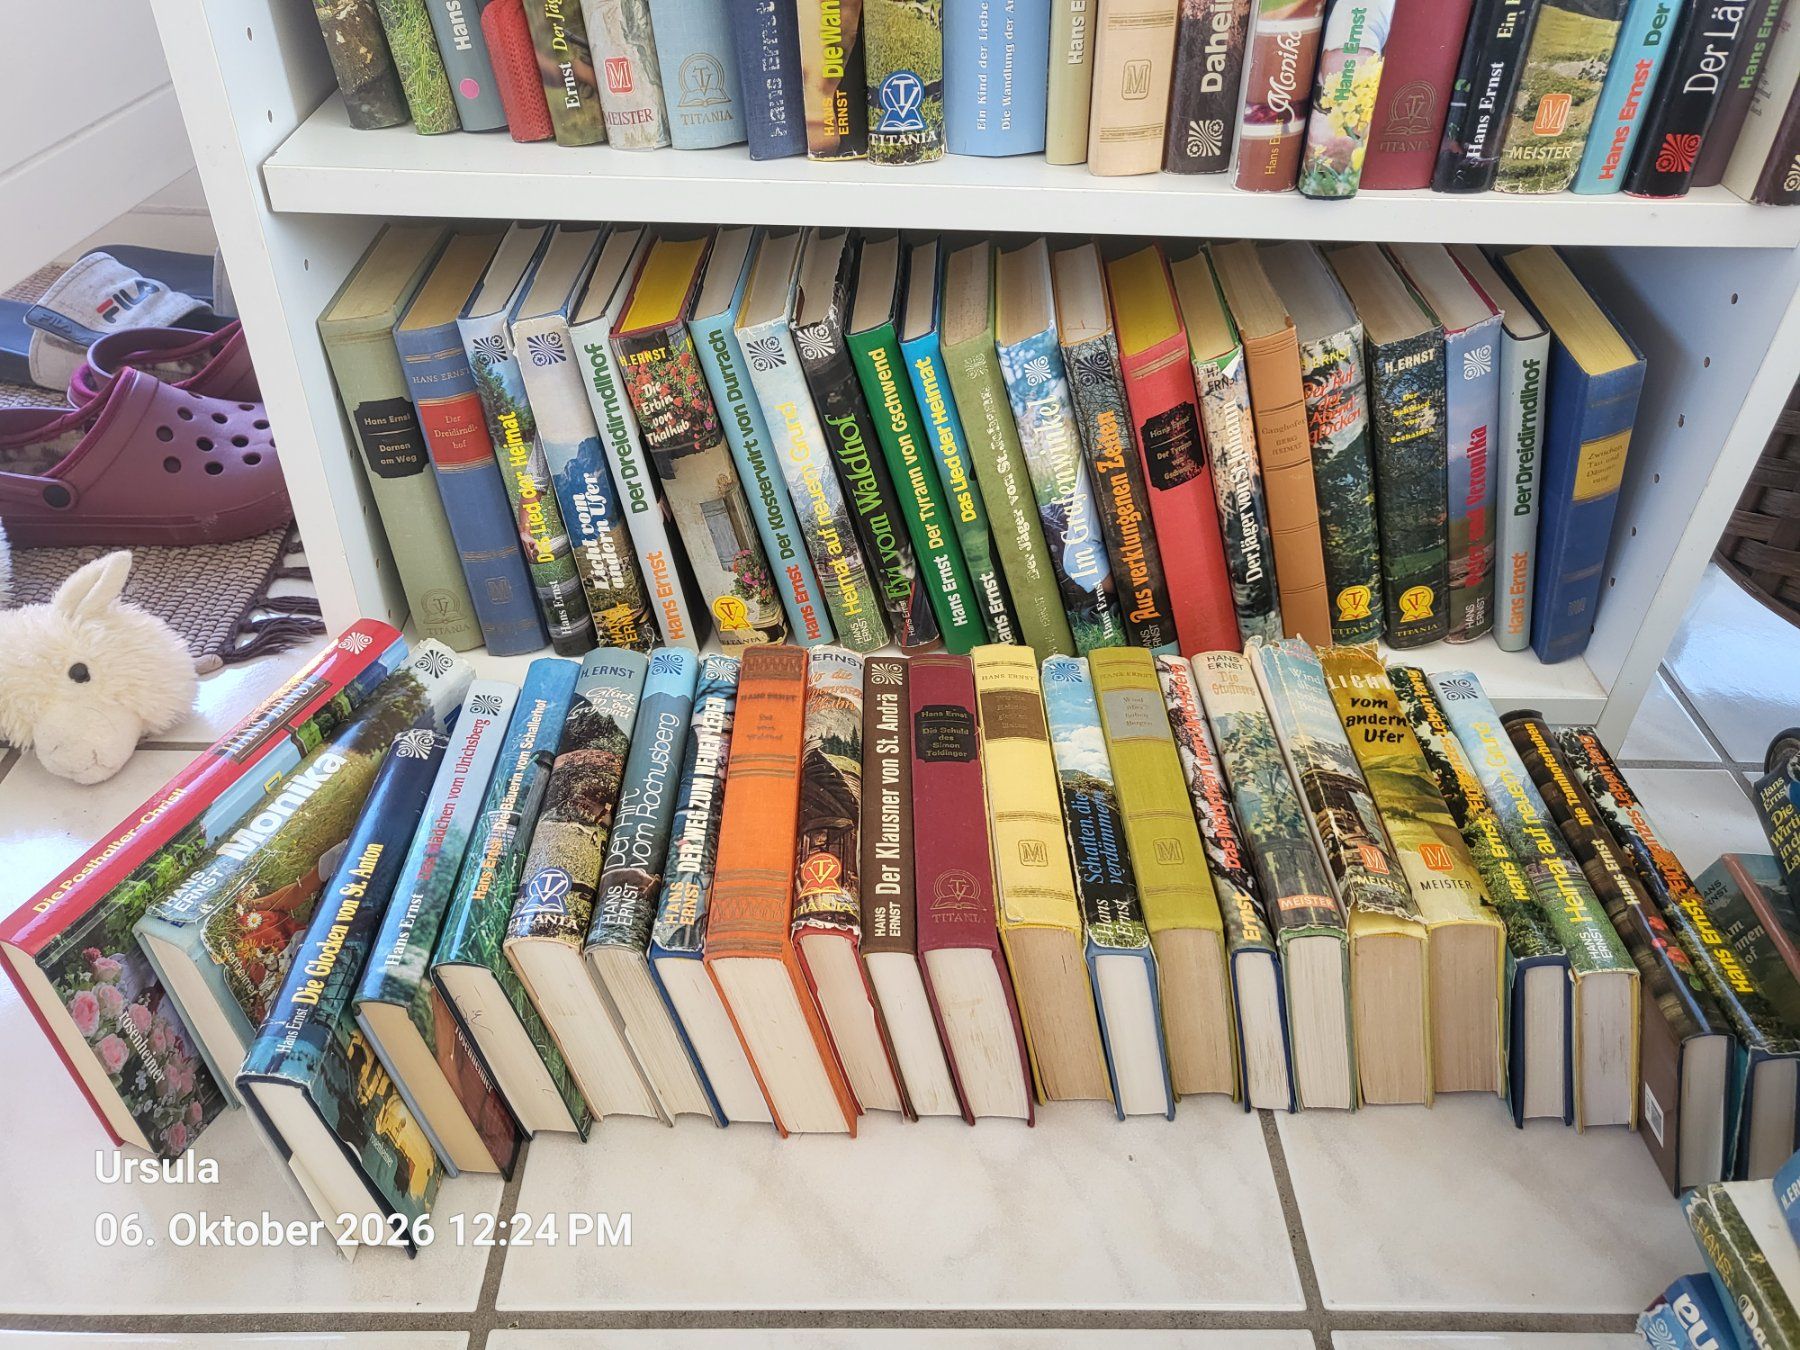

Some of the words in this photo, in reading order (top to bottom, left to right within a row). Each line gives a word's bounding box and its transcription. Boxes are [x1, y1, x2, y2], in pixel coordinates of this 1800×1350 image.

[552, 23, 568, 51] Der
[978, 2, 988, 41] Liebe
[1004, 17, 1014, 40] der
[1343, 8, 1367, 55] Ernst
[978, 45, 988, 68] der
[1067, 16, 1086, 65] Hans
[1002, 44, 1015, 105] Wandlung
[1334, 60, 1356, 101] Hans
[1683, 44, 1729, 95] Der
[1738, 42, 1766, 89] Hans
[558, 61, 581, 109] Ernst
[978, 73, 988, 105] Kind
[1466, 114, 1492, 160] Hans
[1479, 61, 1506, 112] Ernst
[1497, 11, 1519, 39] Ein
[1598, 126, 1630, 180] Hans
[1619, 58, 1653, 121] Ernst
[1643, 3, 1670, 47] Der
[604, 109, 654, 126] MEISTER
[680, 110, 733, 125] TITANIA
[824, 97, 835, 136] HANS
[838, 90, 849, 135] ERNST
[976, 109, 987, 131] Ein
[1002, 109, 1011, 131] Die
[869, 133, 938, 146] TITANIA
[1509, 146, 1574, 160] MEISTER
[619, 347, 667, 367] H.ERNST
[708, 329, 743, 401] Durrach
[1385, 348, 1436, 374] H.ERNST
[641, 383, 661, 398] Die
[641, 395, 674, 415] Erbin
[868, 347, 908, 433] Gschwend
[914, 356, 949, 425] Heimat
[364, 416, 387, 426] Hans
[584, 343, 640, 480] Dreidirndlhof
[652, 412, 673, 427] von
[733, 410, 753, 440] von
[1517, 359, 1541, 485] Dreidirndlhof
[378, 442, 411, 453] Dornen
[498, 411, 529, 468] Heimat
[645, 420, 690, 446] Thalhub
[898, 434, 918, 465] von
[939, 427, 958, 457] der
[397, 453, 417, 464] Weg
[824, 413, 883, 517] Waldhof
[944, 455, 969, 492] Lied
[1467, 424, 1487, 506] Veronika
[625, 482, 649, 514] Der
[742, 439, 786, 530] Klosterwirt
[907, 467, 935, 523] Tyrann
[1514, 485, 1531, 516] Der
[957, 492, 977, 523] Das
[775, 532, 795, 561] Der
[817, 523, 843, 556] auf
[869, 512, 898, 564] vom
[924, 524, 944, 550] Der
[1111, 472, 1149, 595] verklungenen
[1241, 516, 1260, 555] Jäger
[582, 534, 610, 591] Licht
[646, 551, 675, 598] Ernst
[934, 553, 957, 593] Ernst
[1246, 554, 1263, 583] Der
[1510, 551, 1529, 595] Ernst
[786, 563, 809, 604] Ernst
[834, 556, 862, 618] Heimat
[979, 571, 1003, 615] Ernst
[560, 604, 575, 635] Hans
[662, 600, 687, 641] Hans
[800, 605, 822, 640] Hans
[948, 593, 968, 627] Hans
[1103, 610, 1115, 640] Hans
[1465, 603, 1475, 630] HANS
[1476, 597, 1486, 626] ERNST
[1508, 596, 1524, 635] Hans
[849, 623, 863, 650] HANS
[858, 617, 874, 643] ERNST
[1206, 654, 1240, 664] HANS
[1208, 662, 1244, 671] ERNST
[703, 696, 727, 733] LEBEN
[876, 693, 899, 733] Andrä
[921, 711, 944, 719] Hans
[1345, 714, 1407, 727] andern
[1350, 697, 1388, 708] vom
[520, 699, 548, 748] Schallerhof
[940, 727, 969, 735] Schuld
[1364, 728, 1405, 743] Ufer
[454, 718, 491, 774] Ulrichsberg
[515, 750, 530, 771] vom
[695, 732, 720, 777] NEUEN
[876, 735, 900, 754] St.
[635, 713, 680, 820] Rochusberg
[881, 759, 900, 784] von
[1524, 722, 1583, 807] Tannhoferbuben
[447, 769, 466, 806] vom
[500, 770, 524, 812] Bäuerin
[1760, 777, 1784, 800] Hans
[215, 751, 348, 862] Monika
[616, 789, 642, 829] Hirt
[875, 785, 900, 859] Klausner
[1574, 806, 1593, 827] Die
[1771, 804, 1793, 827] Die
[684, 812, 710, 845] WEG
[1477, 816, 1509, 859] Ernst
[1522, 826, 1557, 855] auf
[32, 890, 66, 914] Die
[61, 787, 187, 891] Posthalter-Christl
[357, 843, 384, 886] Anton
[604, 826, 631, 870] Der
[630, 822, 656, 872] vom
[677, 842, 704, 872] DER
[1591, 838, 1619, 874] Ernst
[1779, 843, 1792, 860] in
[165, 870, 206, 908] HANS
[173, 867, 225, 912] ERNST
[340, 876, 367, 898] St.
[472, 869, 493, 901] Hans
[875, 865, 901, 895] Der
[1420, 879, 1473, 891] MEISTER
[1499, 860, 1531, 901] Hans
[1540, 855, 1593, 925] Heimat
[1613, 872, 1642, 906] Hans
[336, 898, 358, 926] von
[399, 893, 424, 929] Ernst
[601, 886, 623, 925] HANS
[617, 882, 639, 926] ERNST
[664, 881, 684, 925] HANS
[680, 882, 700, 926] ERNST
[889, 901, 901, 937] ERNST
[1096, 899, 1114, 936] Hans
[1115, 899, 1134, 937] Ernst
[1233, 891, 1262, 942] Ernst
[875, 906, 886, 937] HANS
[1680, 898, 1722, 945] Ernst
[304, 922, 346, 977] Glocken
[385, 923, 412, 966] Hans
[1579, 930, 1599, 960] HANS
[1589, 924, 1613, 959] ERNST
[1713, 948, 1754, 993] Hans
[292, 974, 325, 1006] Die
[285, 1008, 309, 1030] Ernst
[118, 1010, 166, 1084] rosenheimer
[276, 1028, 299, 1053] Hans
